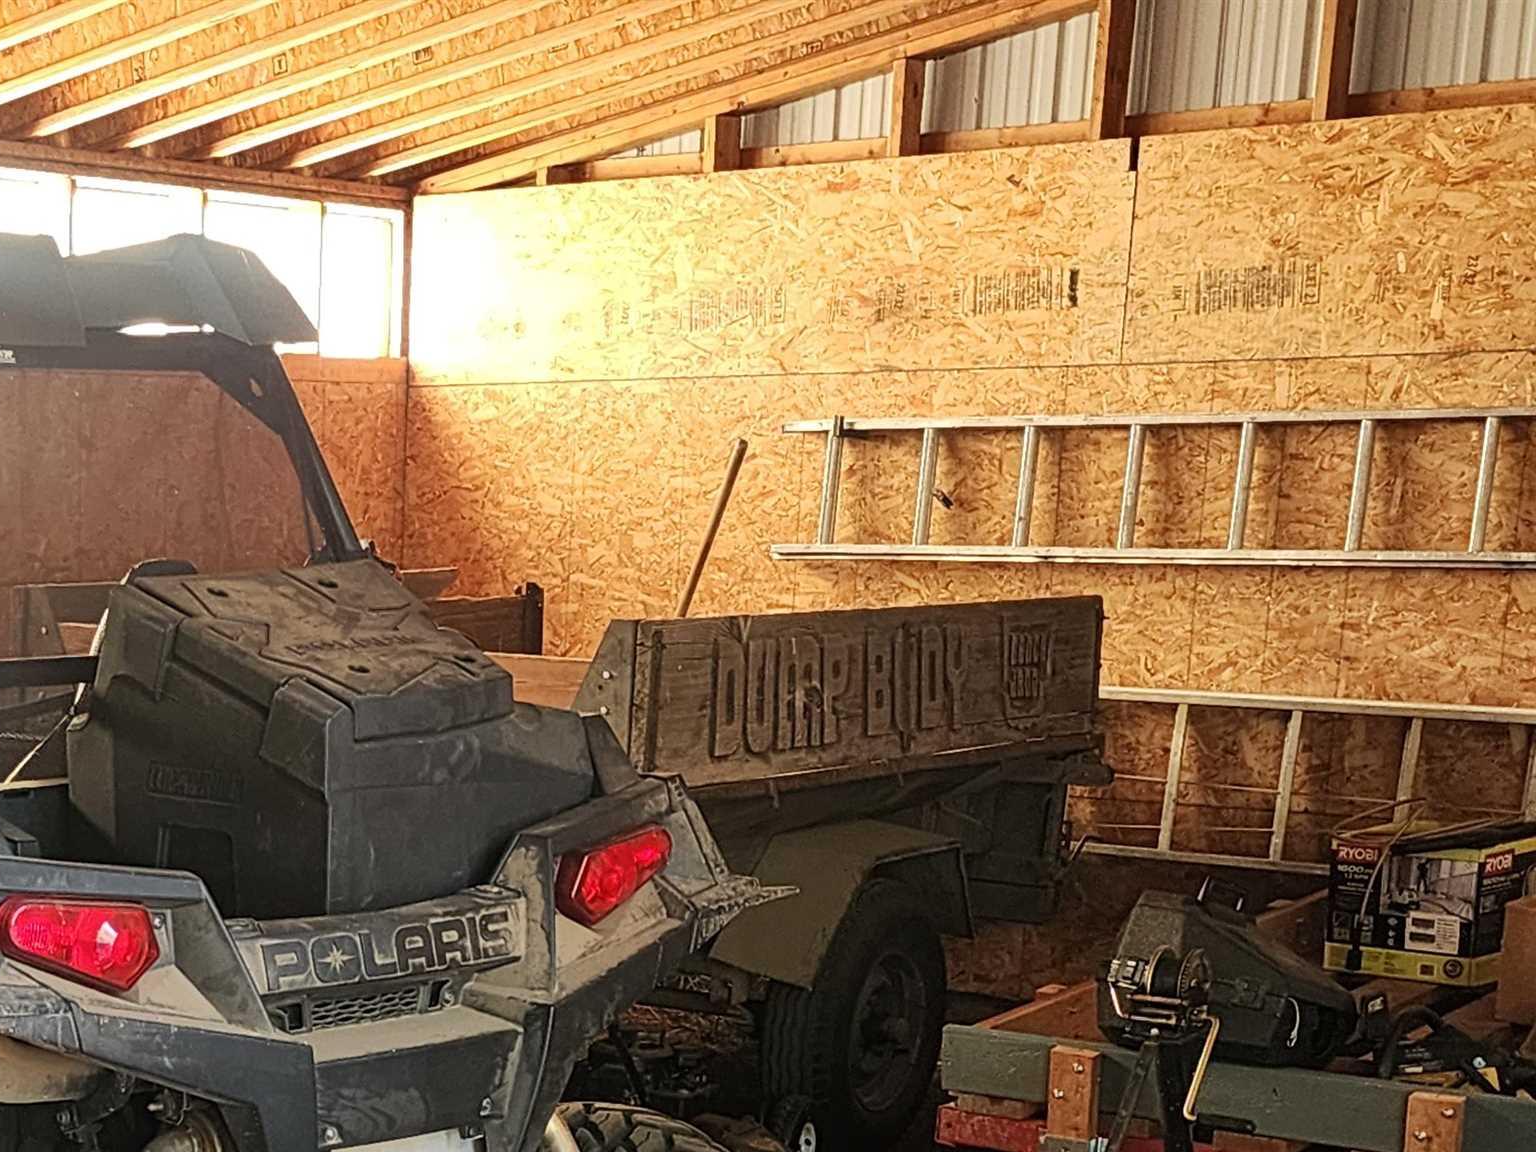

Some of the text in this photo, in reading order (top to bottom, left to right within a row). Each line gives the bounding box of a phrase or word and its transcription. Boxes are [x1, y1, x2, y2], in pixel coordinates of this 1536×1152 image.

[1338, 846, 1379, 862] RYOBI
[1484, 853, 1513, 873] RYOBI
[260, 906, 514, 993] POLARIS
